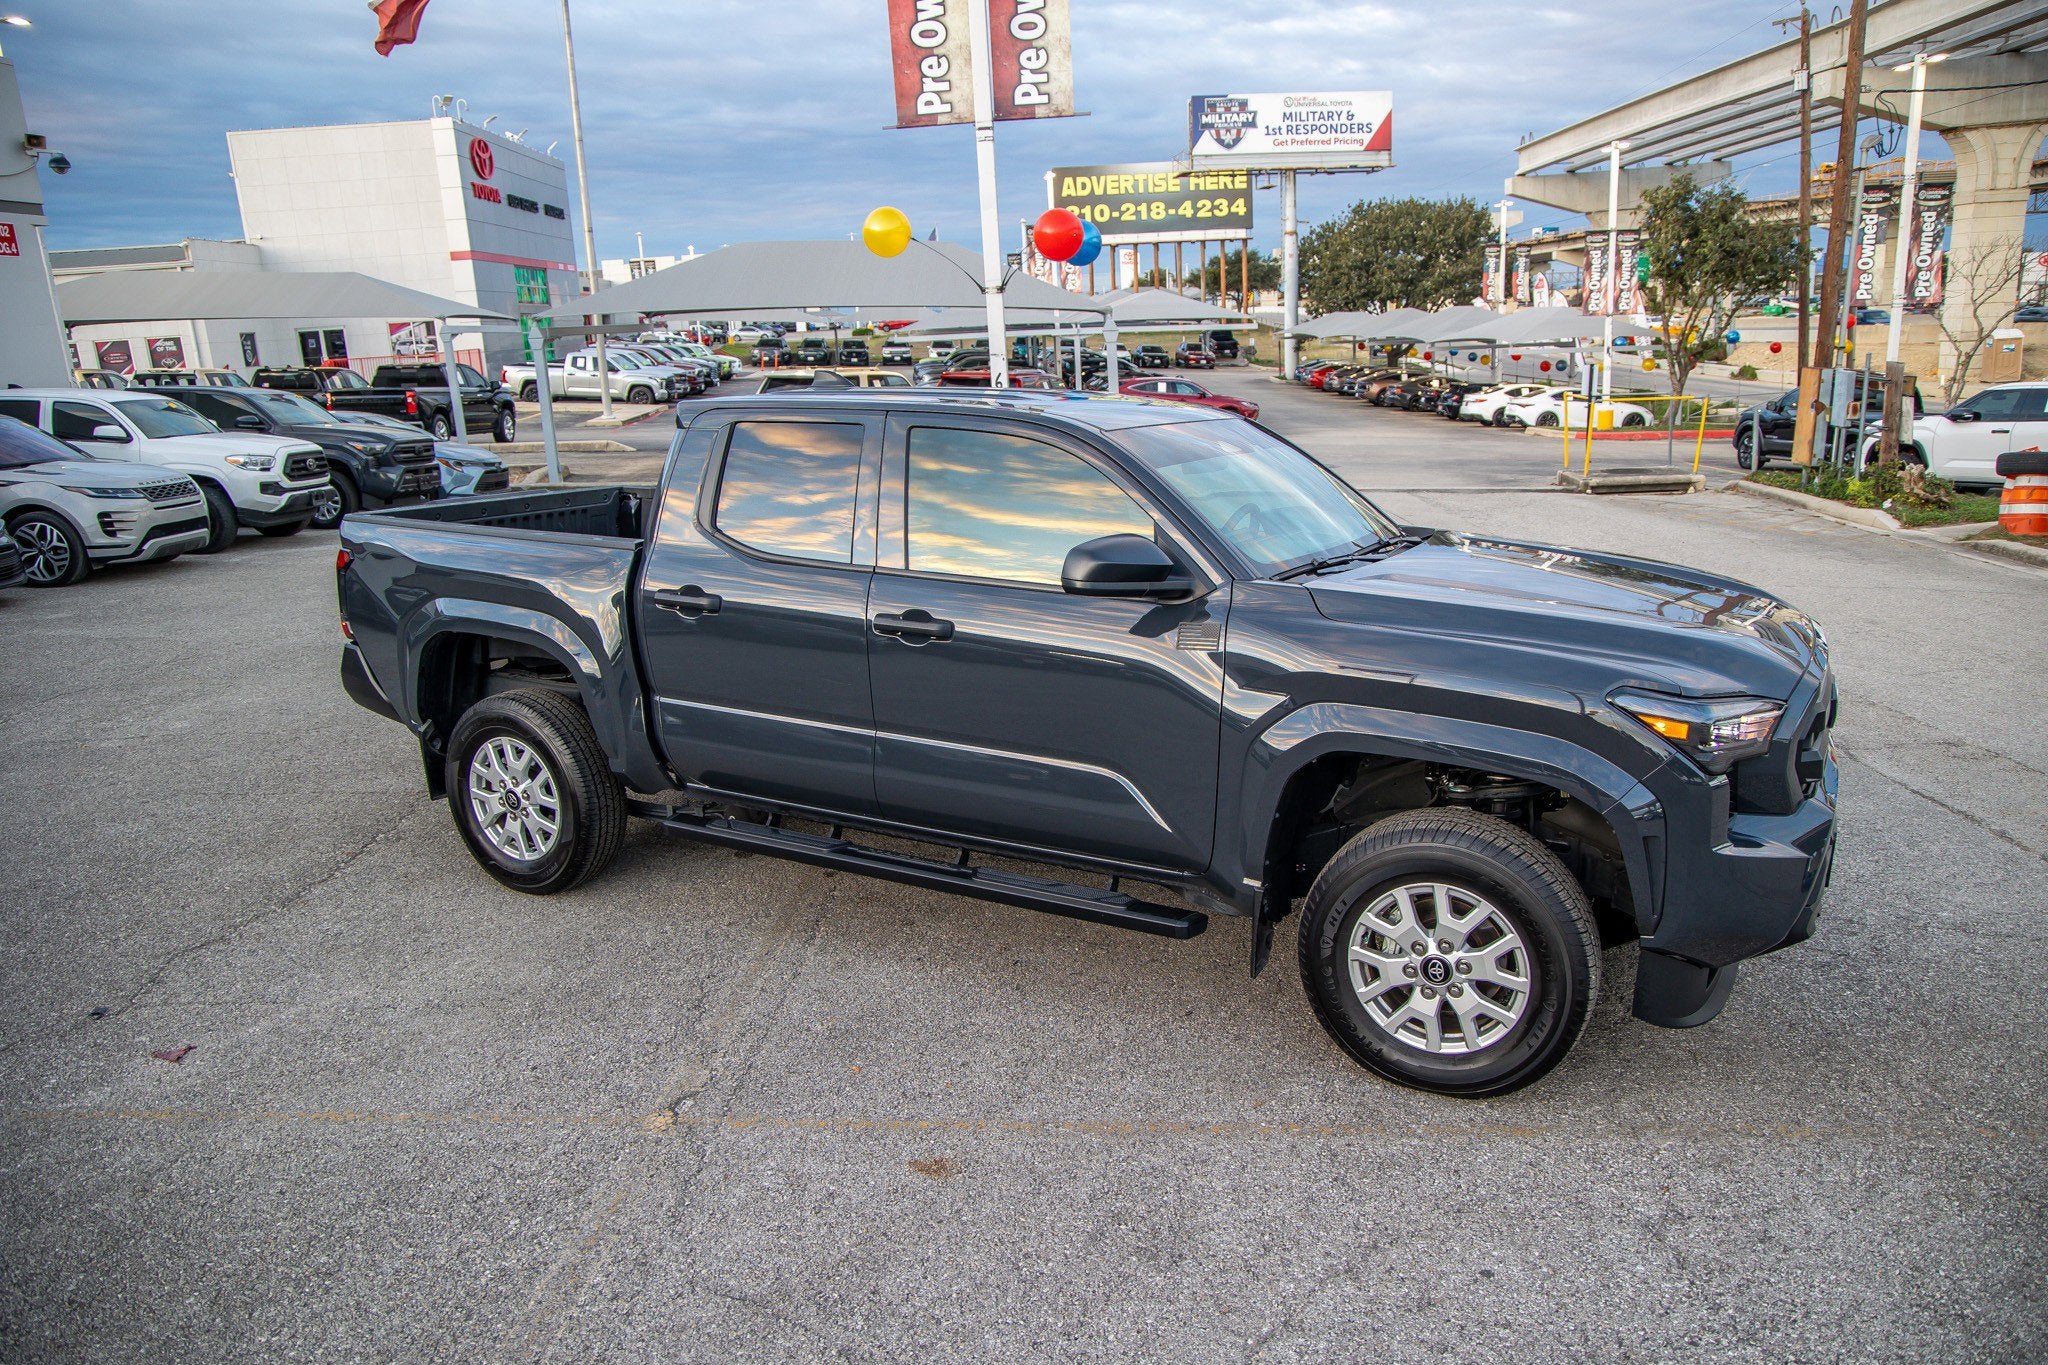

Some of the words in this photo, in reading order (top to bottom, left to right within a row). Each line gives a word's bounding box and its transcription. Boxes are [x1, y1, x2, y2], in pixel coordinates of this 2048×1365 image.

[916, 54, 952, 115] Pre
[1013, 47, 1050, 106] Pre
[1201, 112, 1255, 124] MILITARY
[1264, 125, 1282, 136] 1st
[1286, 122, 1373, 135] RESPONDERS
[1282, 110, 1343, 122] MILITARY
[1346, 110, 1355, 121] &
[1273, 138, 1289, 147] Get
[1291, 137, 1332, 146] Preferred
[1334, 137, 1364, 147] Pricing
[471, 182, 502, 204] TOYOTA
[1061, 172, 1181, 198] ADVERTISE
[1189, 168, 1248, 191] HERE
[1857, 213, 1879, 270] Owned
[1915, 211, 1937, 268] Owned
[1487, 257, 1496, 285] Owned
[1516, 257, 1526, 285] Owned
[1588, 250, 1602, 291] Owned
[1619, 250, 1632, 290] Owned
[1914, 270, 1932, 297] Pre
[1486, 287, 1496, 300] Pre
[1516, 286, 1525, 300] Pre
[1856, 273, 1873, 300] Pre
[1588, 292, 1600, 311] Pre
[1619, 291, 1631, 311] Pre
[995, 372, 1003, 388] 6
